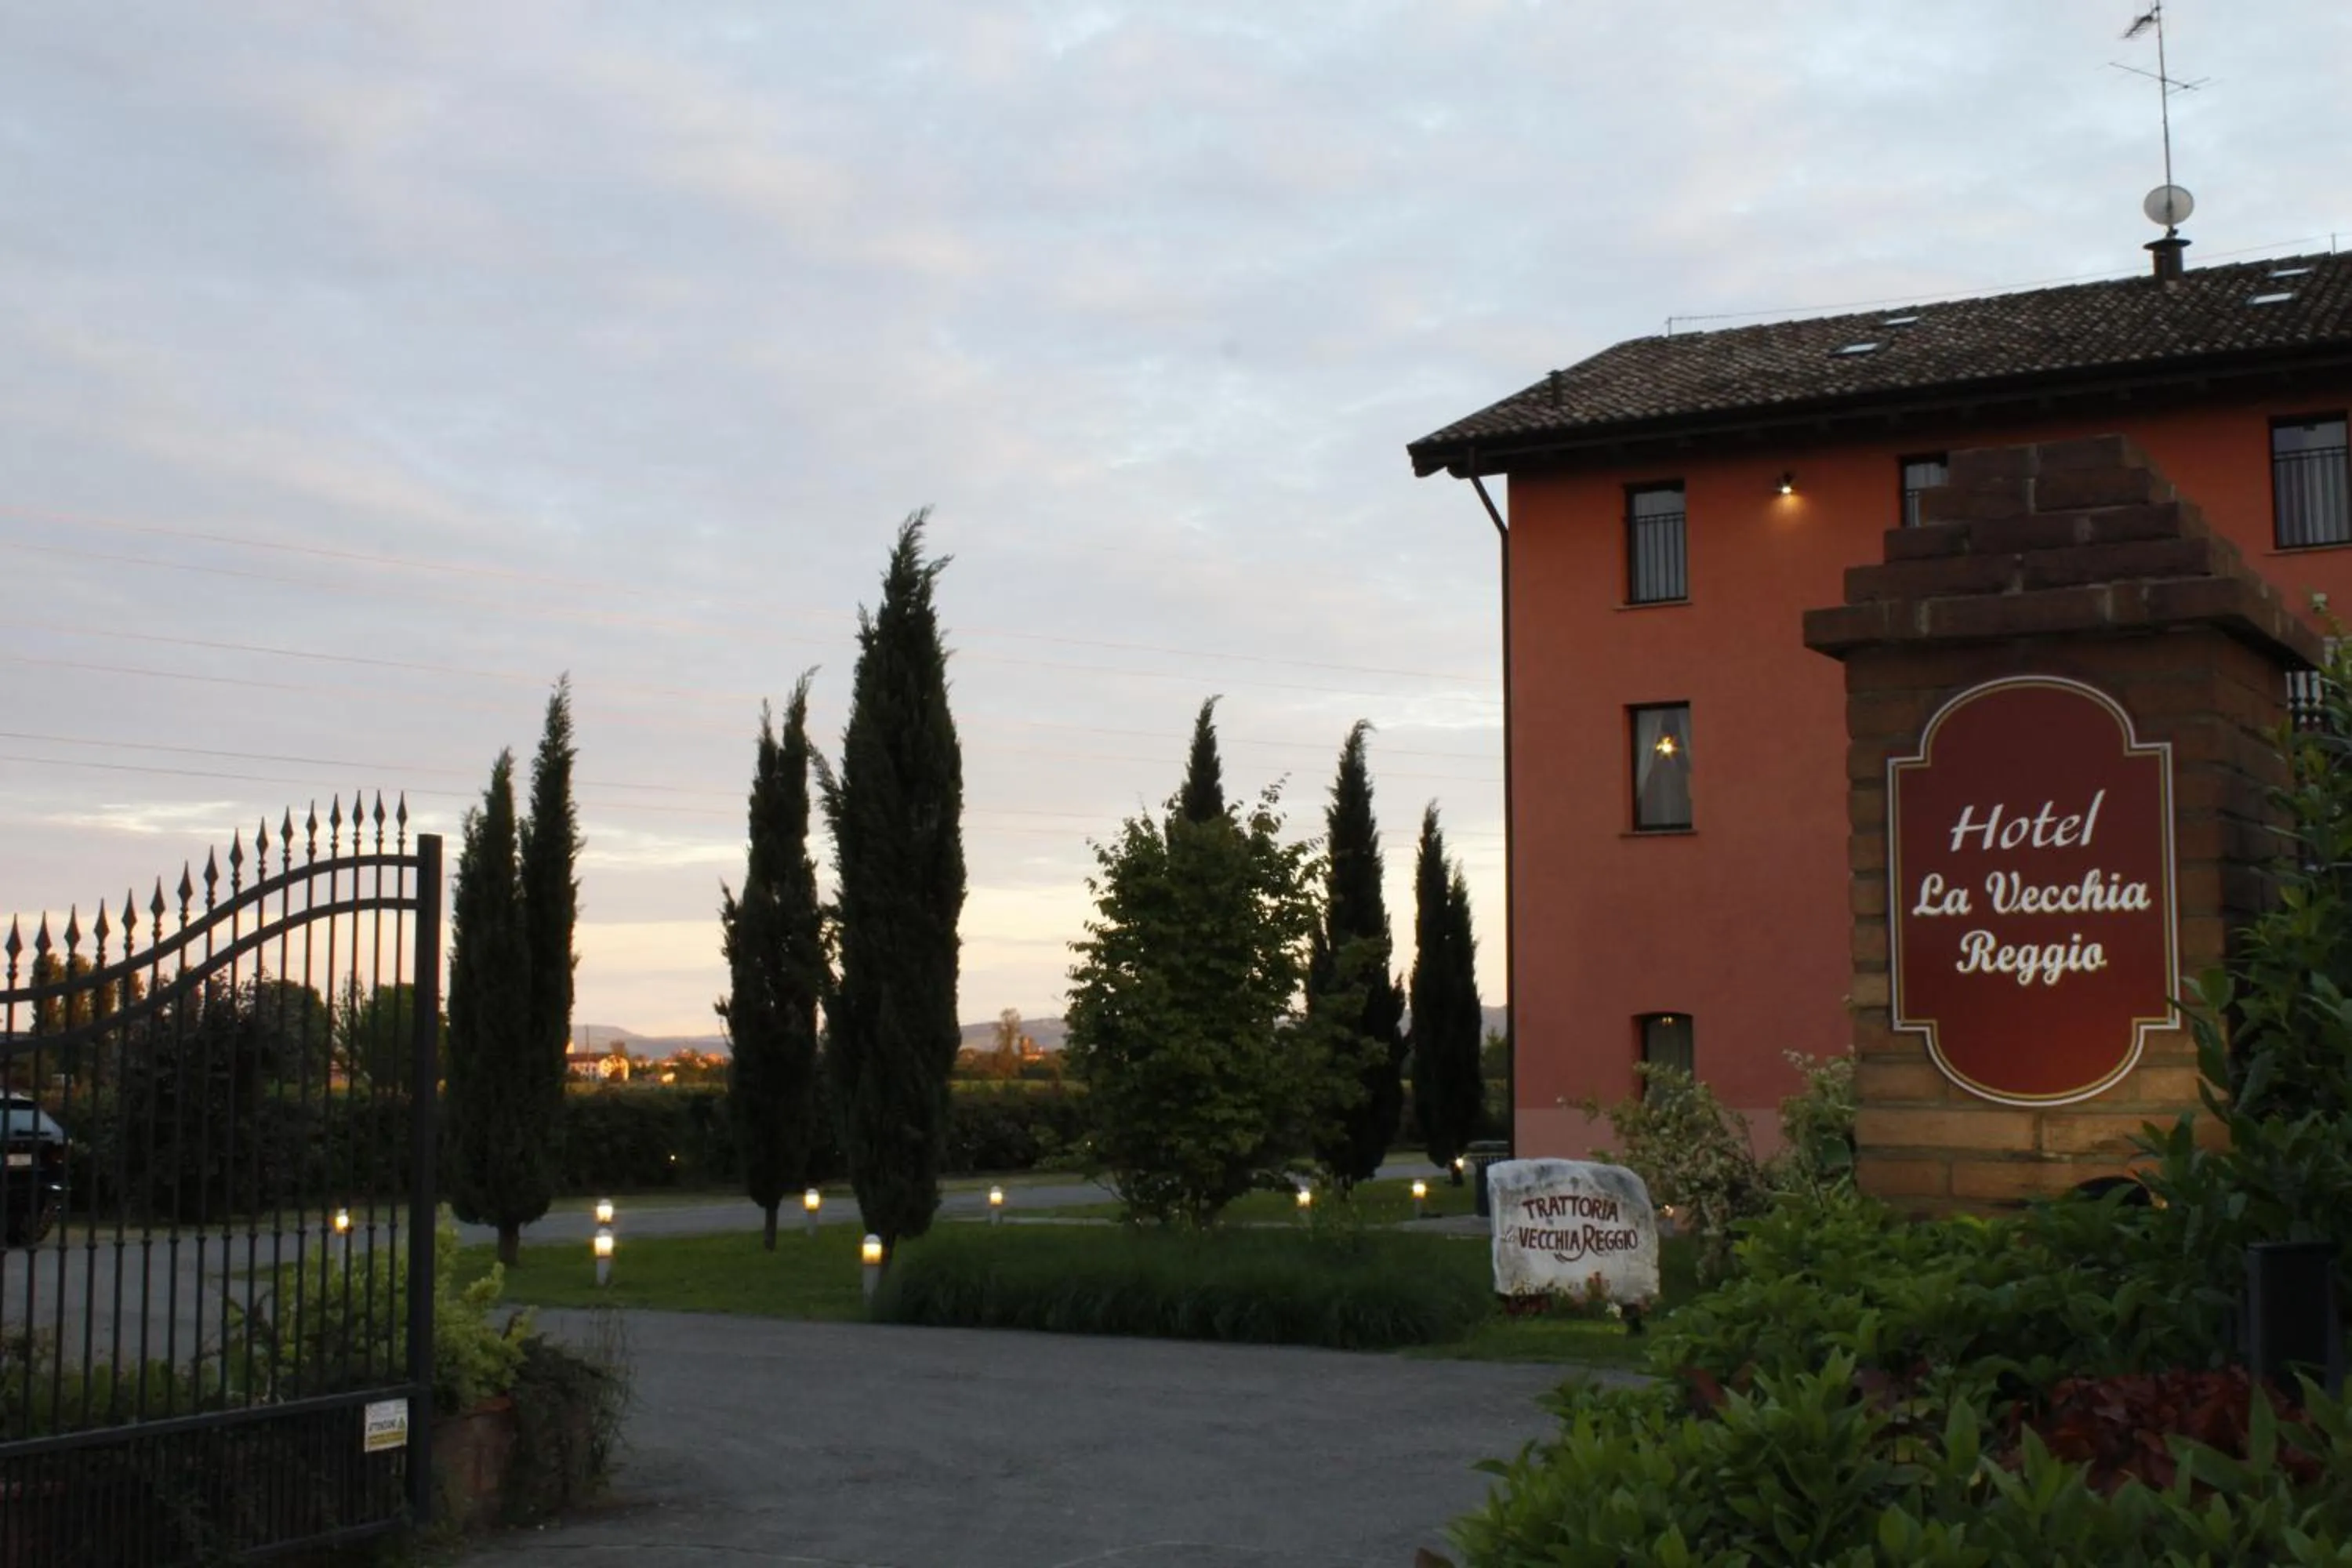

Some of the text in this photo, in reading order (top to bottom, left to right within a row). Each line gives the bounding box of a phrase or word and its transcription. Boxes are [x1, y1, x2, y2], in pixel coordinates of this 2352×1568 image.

[1950, 789, 2106, 851] Hotel
[1912, 868, 2151, 916] La Vecchia
[1956, 930, 2107, 985] Reggio
[1522, 1196, 1619, 1222] TRATTORIA
